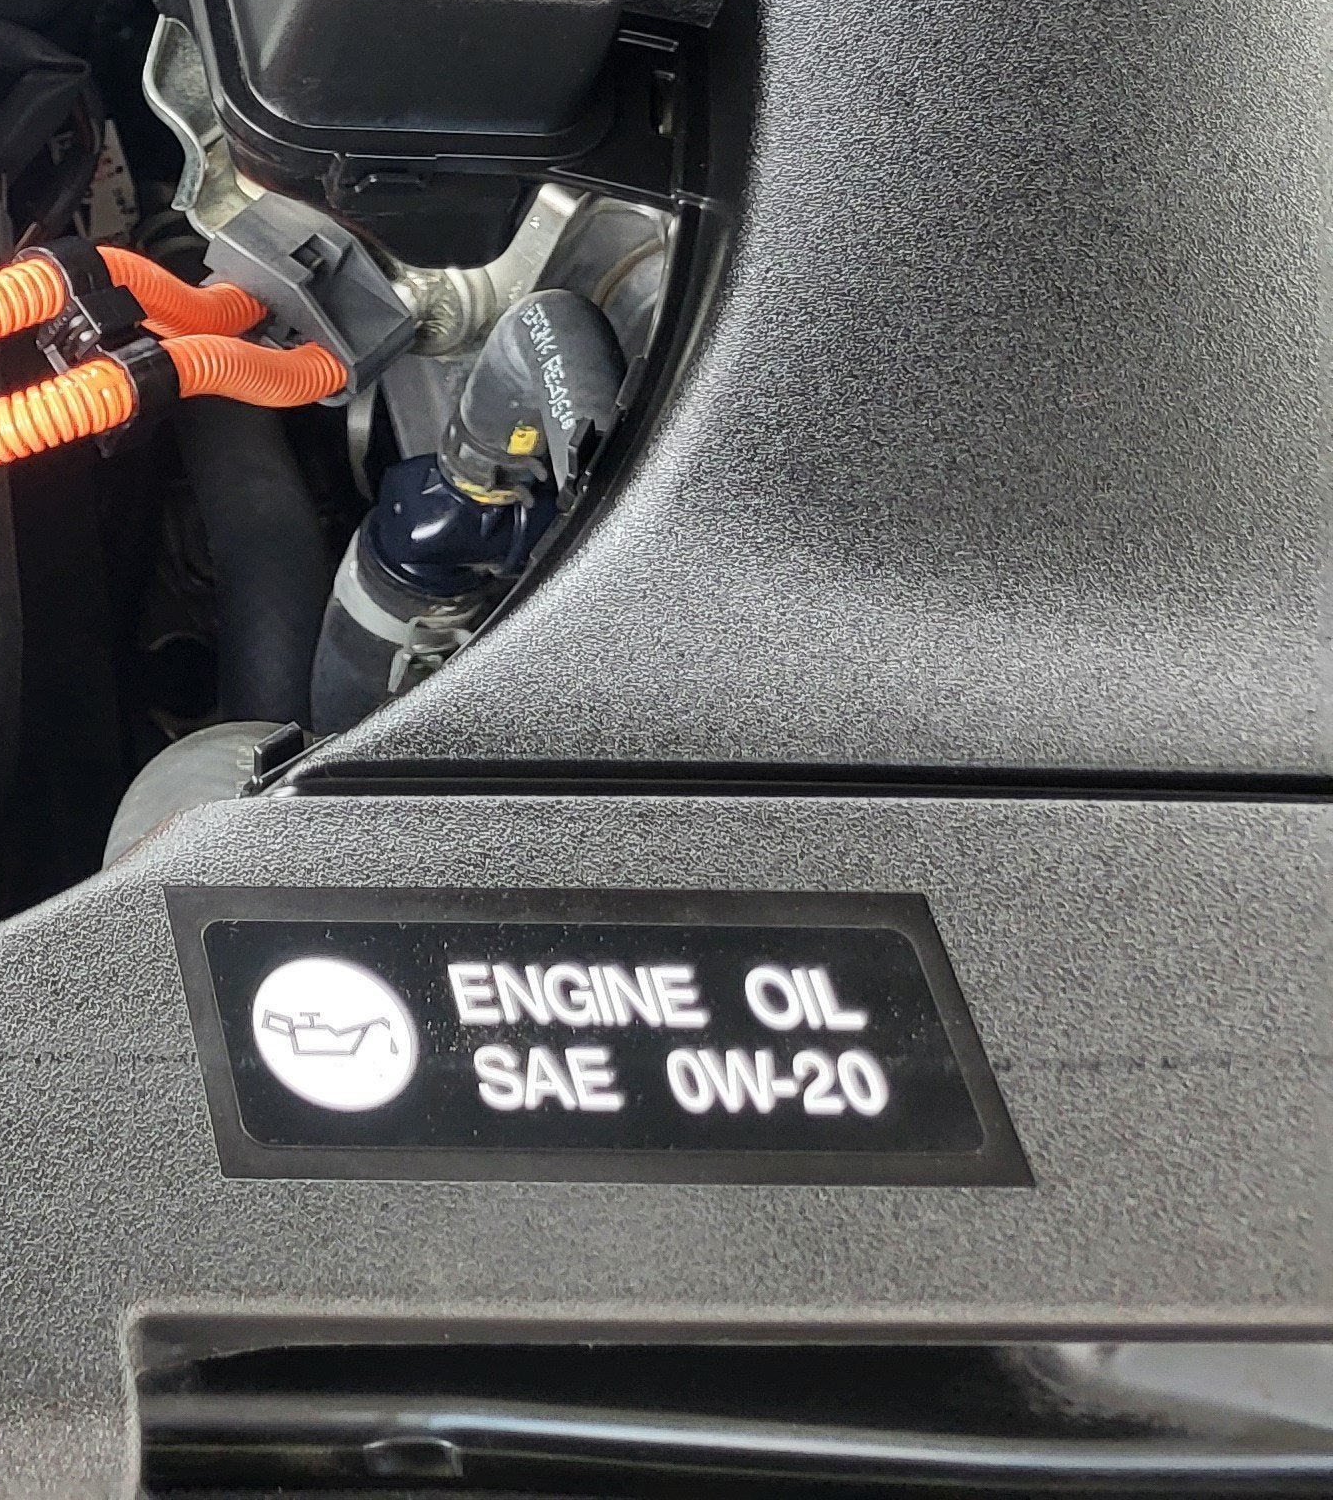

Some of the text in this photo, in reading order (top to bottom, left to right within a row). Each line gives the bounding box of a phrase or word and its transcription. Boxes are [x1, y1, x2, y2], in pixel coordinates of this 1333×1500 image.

[446, 960, 869, 1032] ENGINE OIL
[473, 1043, 890, 1117] SAE 0W-20
